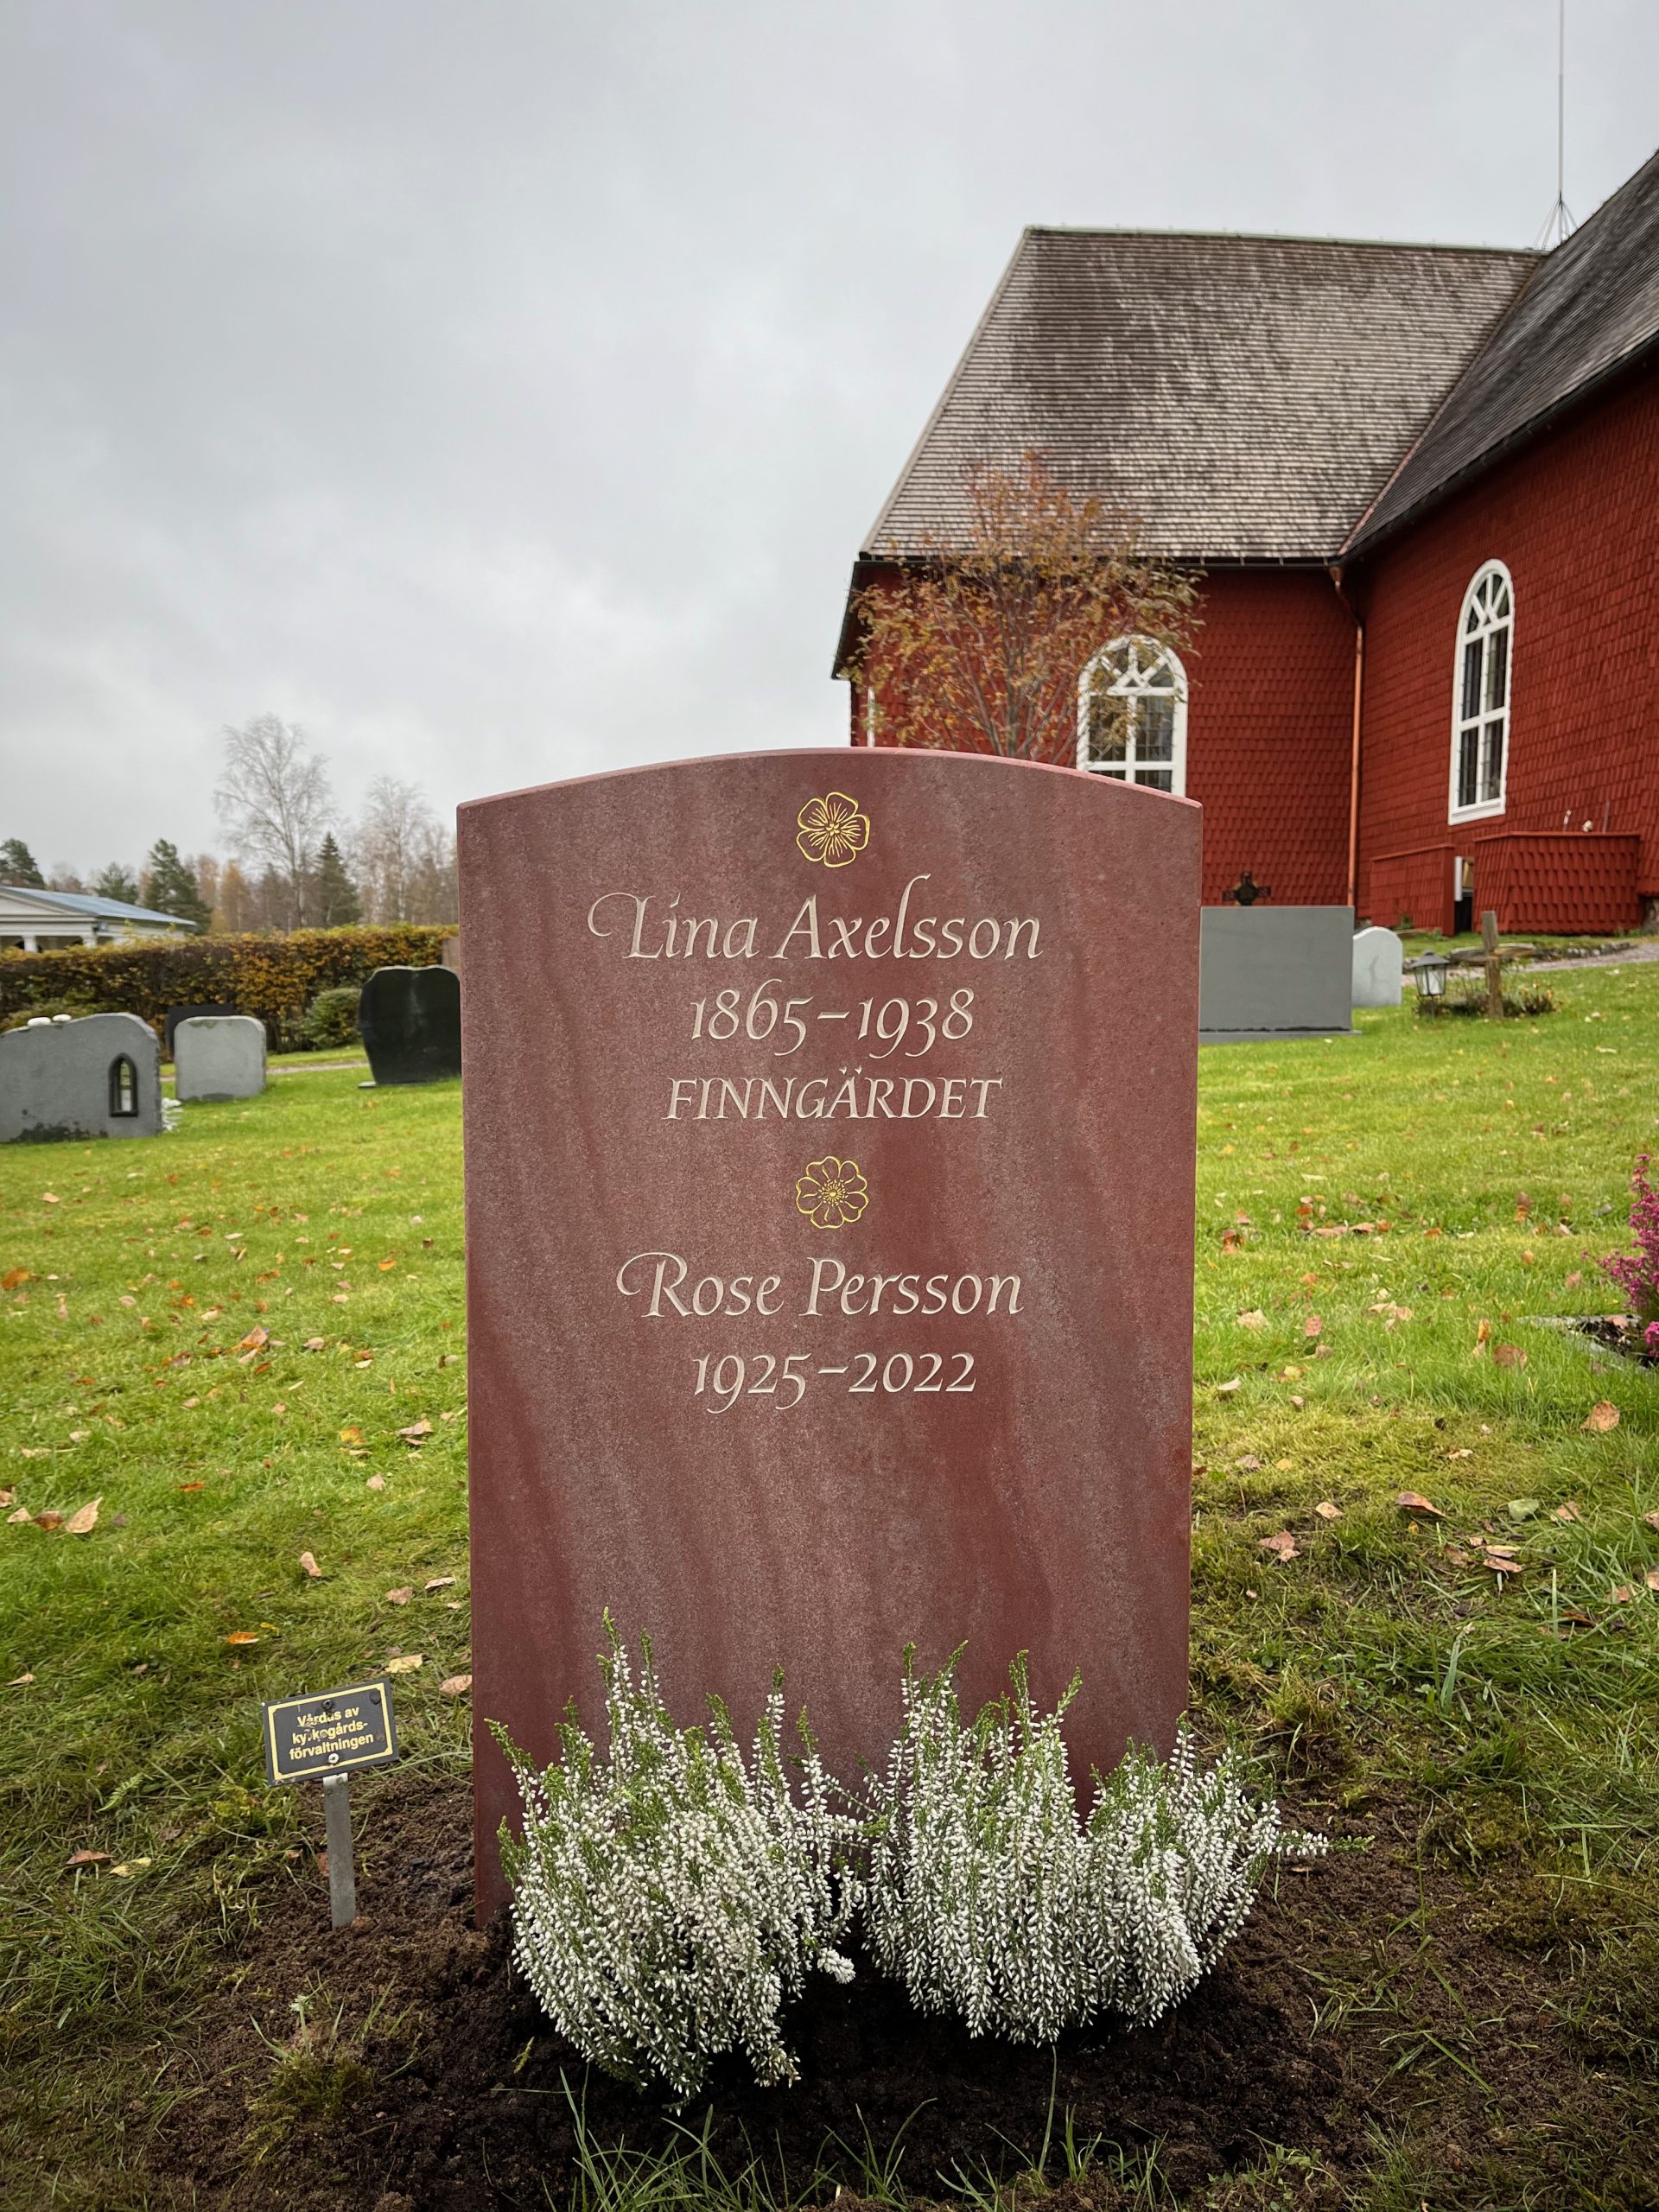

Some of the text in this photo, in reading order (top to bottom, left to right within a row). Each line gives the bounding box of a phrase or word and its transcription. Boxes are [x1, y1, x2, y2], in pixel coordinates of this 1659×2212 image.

[588, 873, 1044, 960] Lina Axelsson
[662, 1065, 1002, 1120] FINNGÄRDET
[615, 1251, 1025, 1319] Rose Persson
[344, 1707, 359, 1718] av
[289, 1733, 374, 1760] förvaltningen
